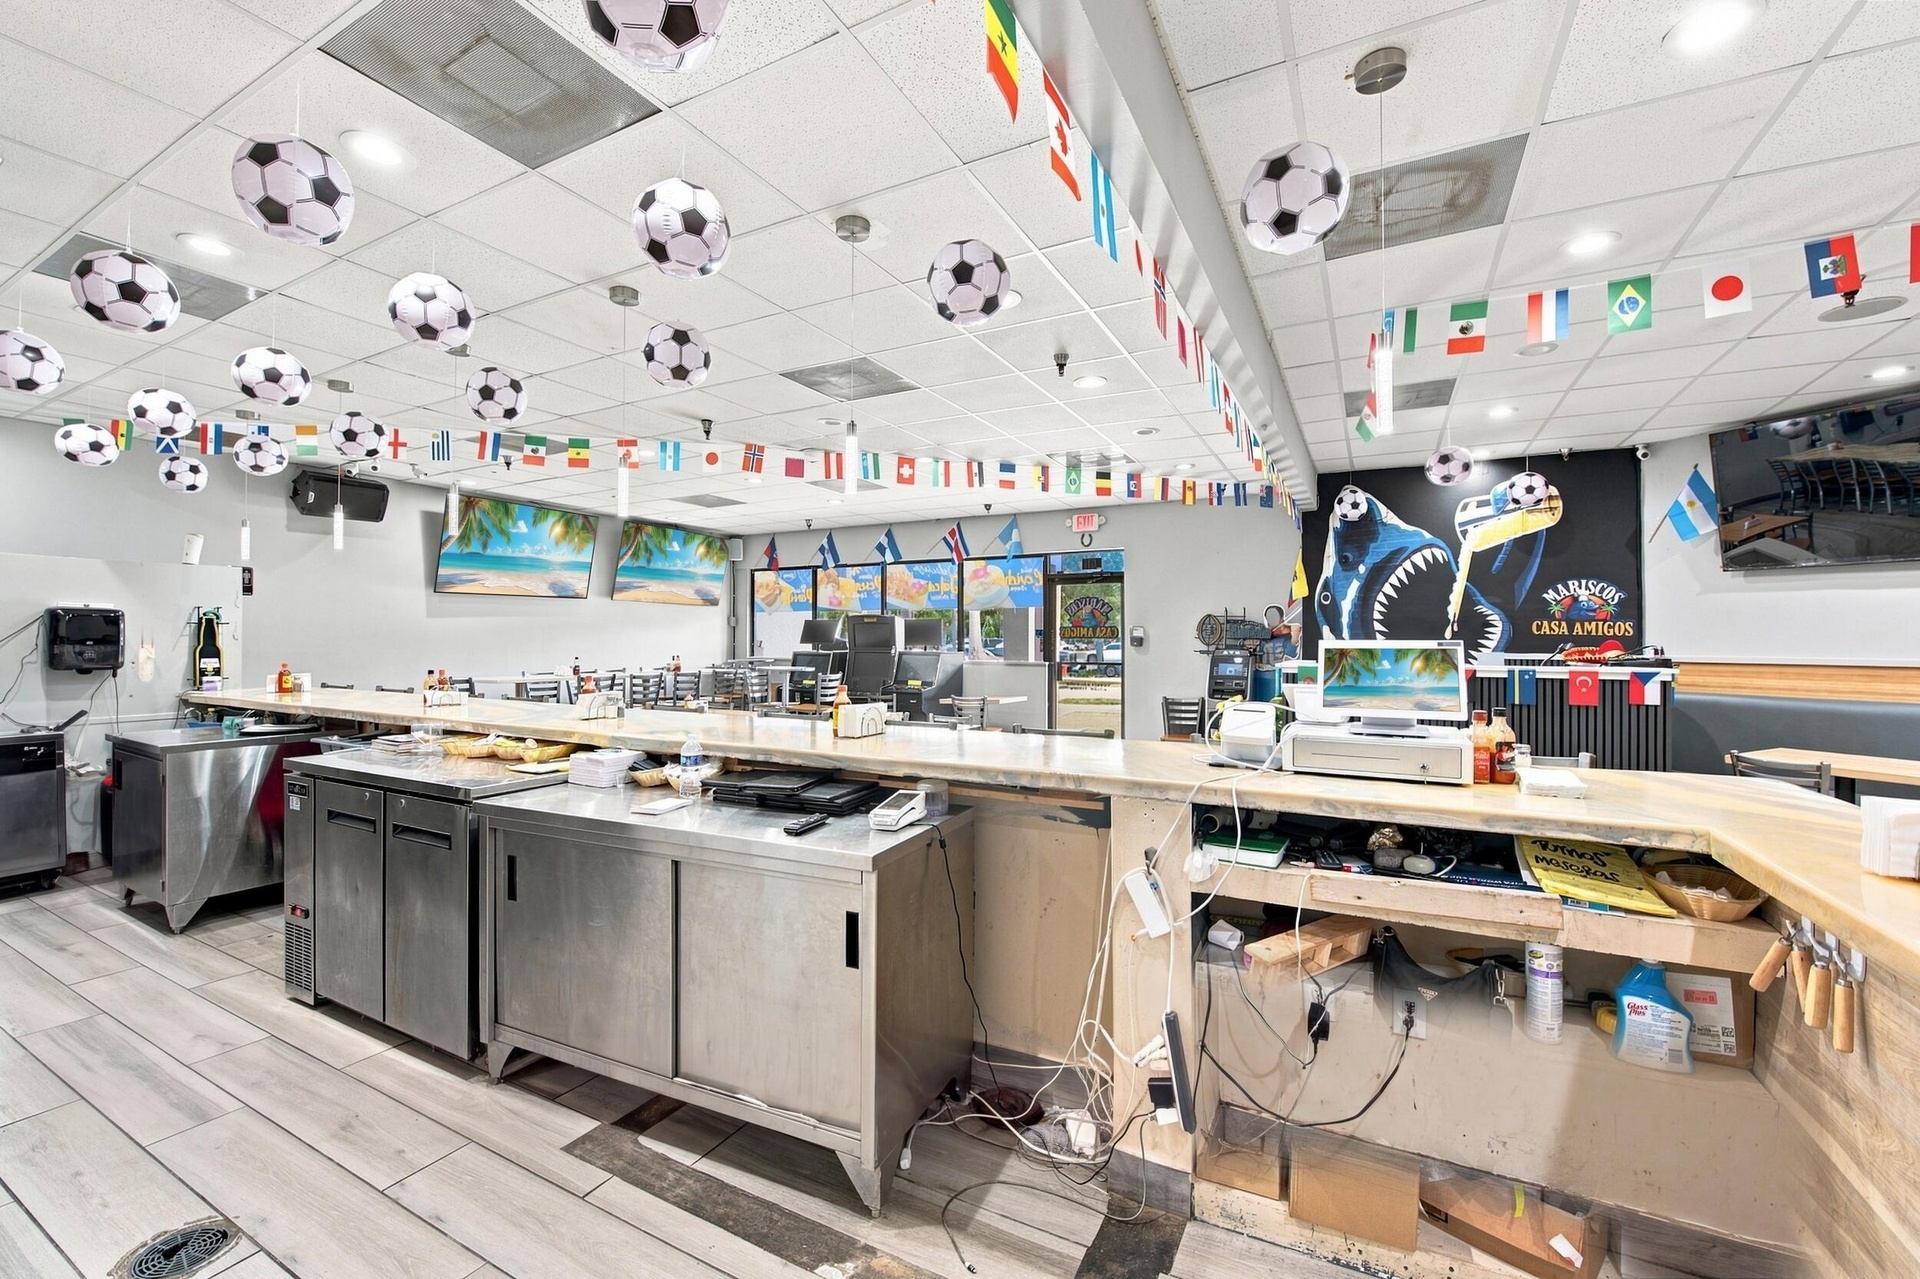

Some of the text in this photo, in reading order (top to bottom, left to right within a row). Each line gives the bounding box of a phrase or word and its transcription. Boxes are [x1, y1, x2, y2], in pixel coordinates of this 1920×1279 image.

[1076, 514, 1096, 529] EXIT
[1541, 579, 1626, 605] MARISCOS
[1532, 620, 1634, 636] CASA AMIGOS
[1627, 1002, 1648, 1011] Glass
